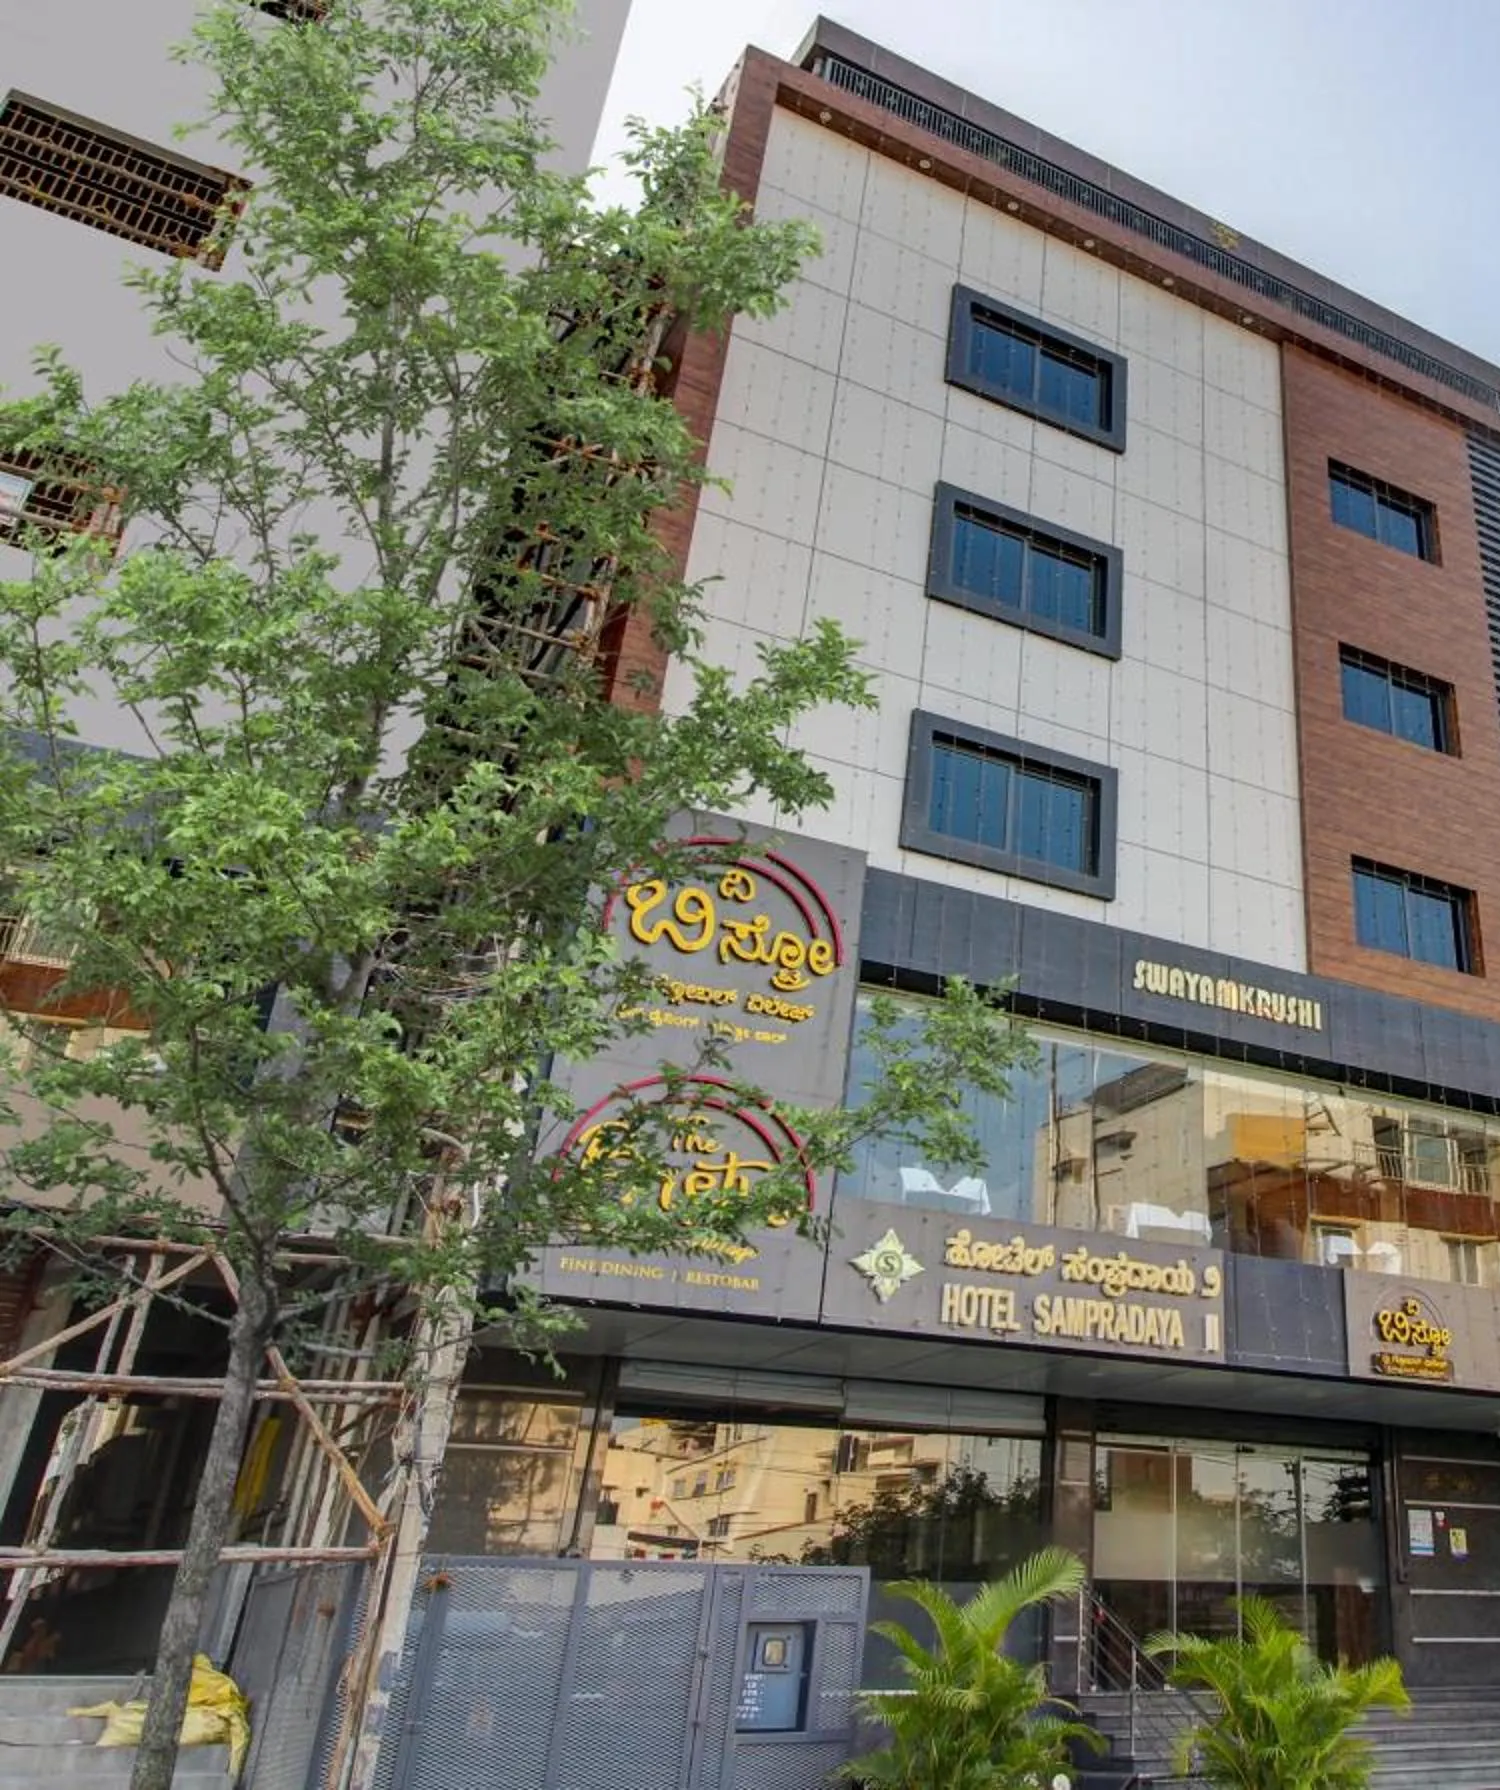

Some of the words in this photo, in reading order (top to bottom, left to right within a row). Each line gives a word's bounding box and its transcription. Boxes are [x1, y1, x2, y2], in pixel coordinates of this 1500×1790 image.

[1133, 959, 1322, 1031] SWAYAMKRUSHI
[600, 1262, 664, 1281] DINING
[685, 1270, 760, 1290] RESTOBAR
[945, 1228, 1055, 1275] ಹೋಟೆಲ್
[941, 1283, 1021, 1332] HOTEL
[1032, 1294, 1185, 1348] SAMPRADAYA
